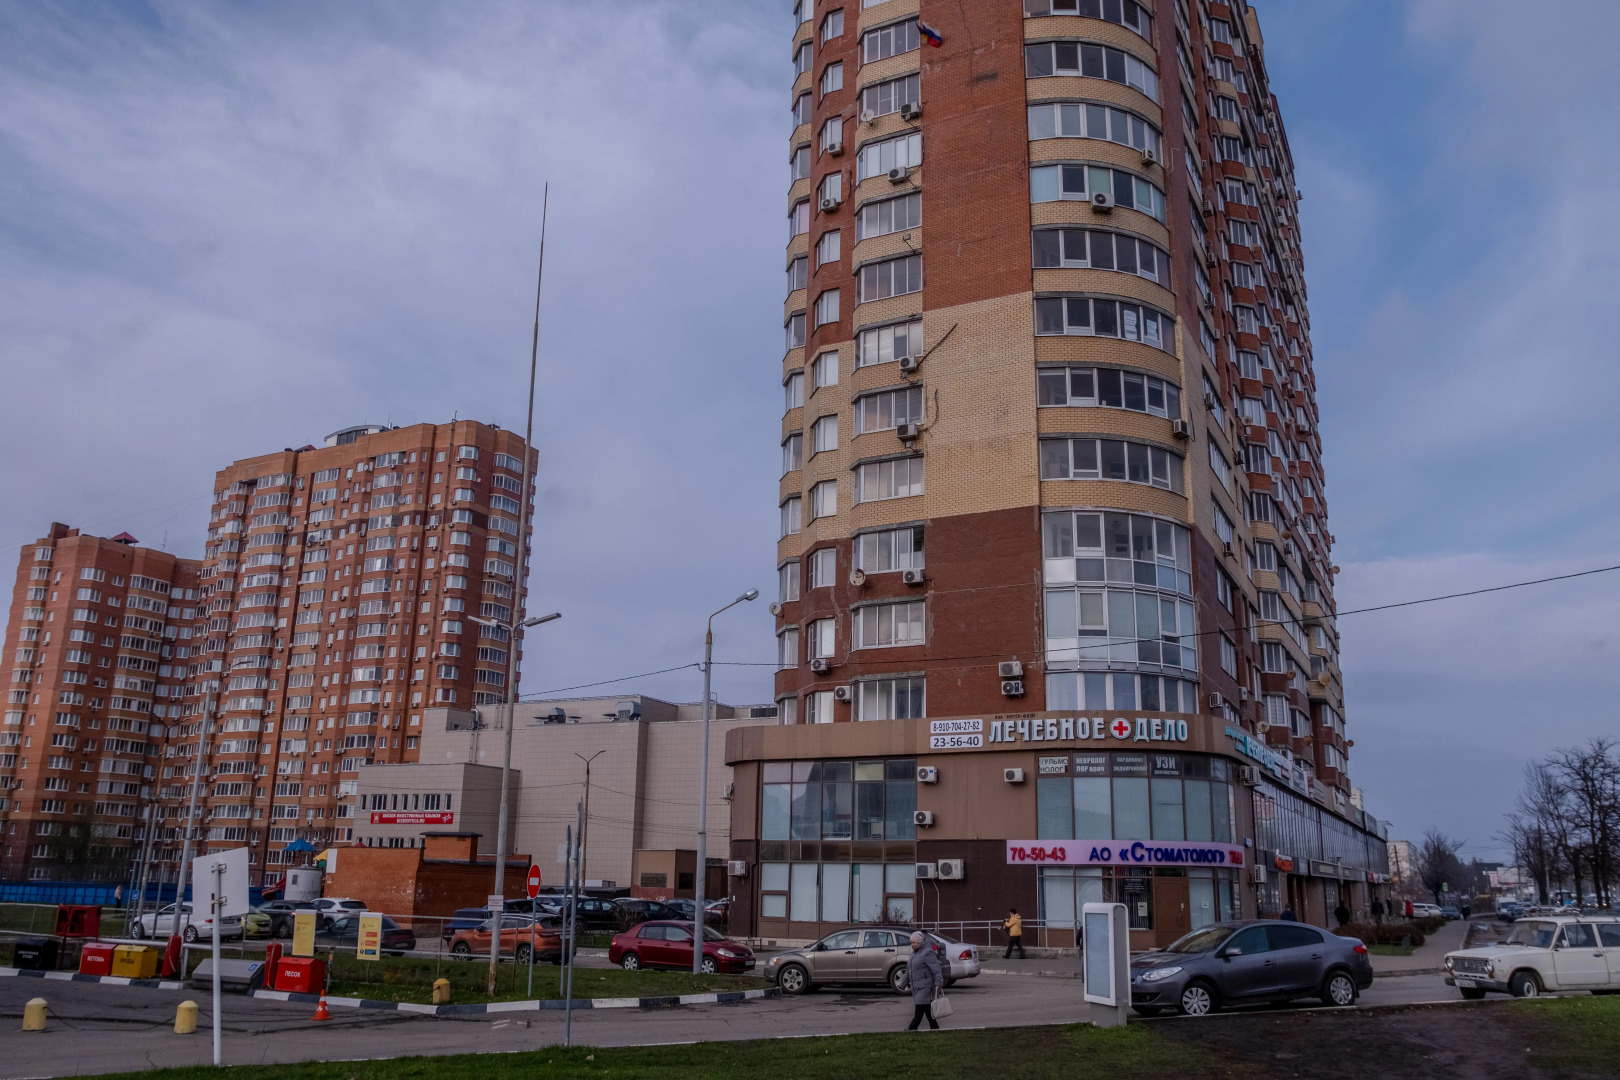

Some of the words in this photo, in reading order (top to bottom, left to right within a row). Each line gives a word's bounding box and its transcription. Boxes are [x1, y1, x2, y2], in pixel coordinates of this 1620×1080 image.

[932, 720, 980, 732] 8-910-704-27-82
[988, 717, 1106, 743] ЛЕЧЕБНОЕ
[1133, 717, 1188, 743] ДЕЛО
[933, 736, 980, 748] 23-56-40
[1155, 755, 1176, 769] УЗИ
[1010, 846, 1066, 861] 70-50-43
[1089, 847, 1111, 862] АО
[284, 970, 301, 978] ПЕСОК
